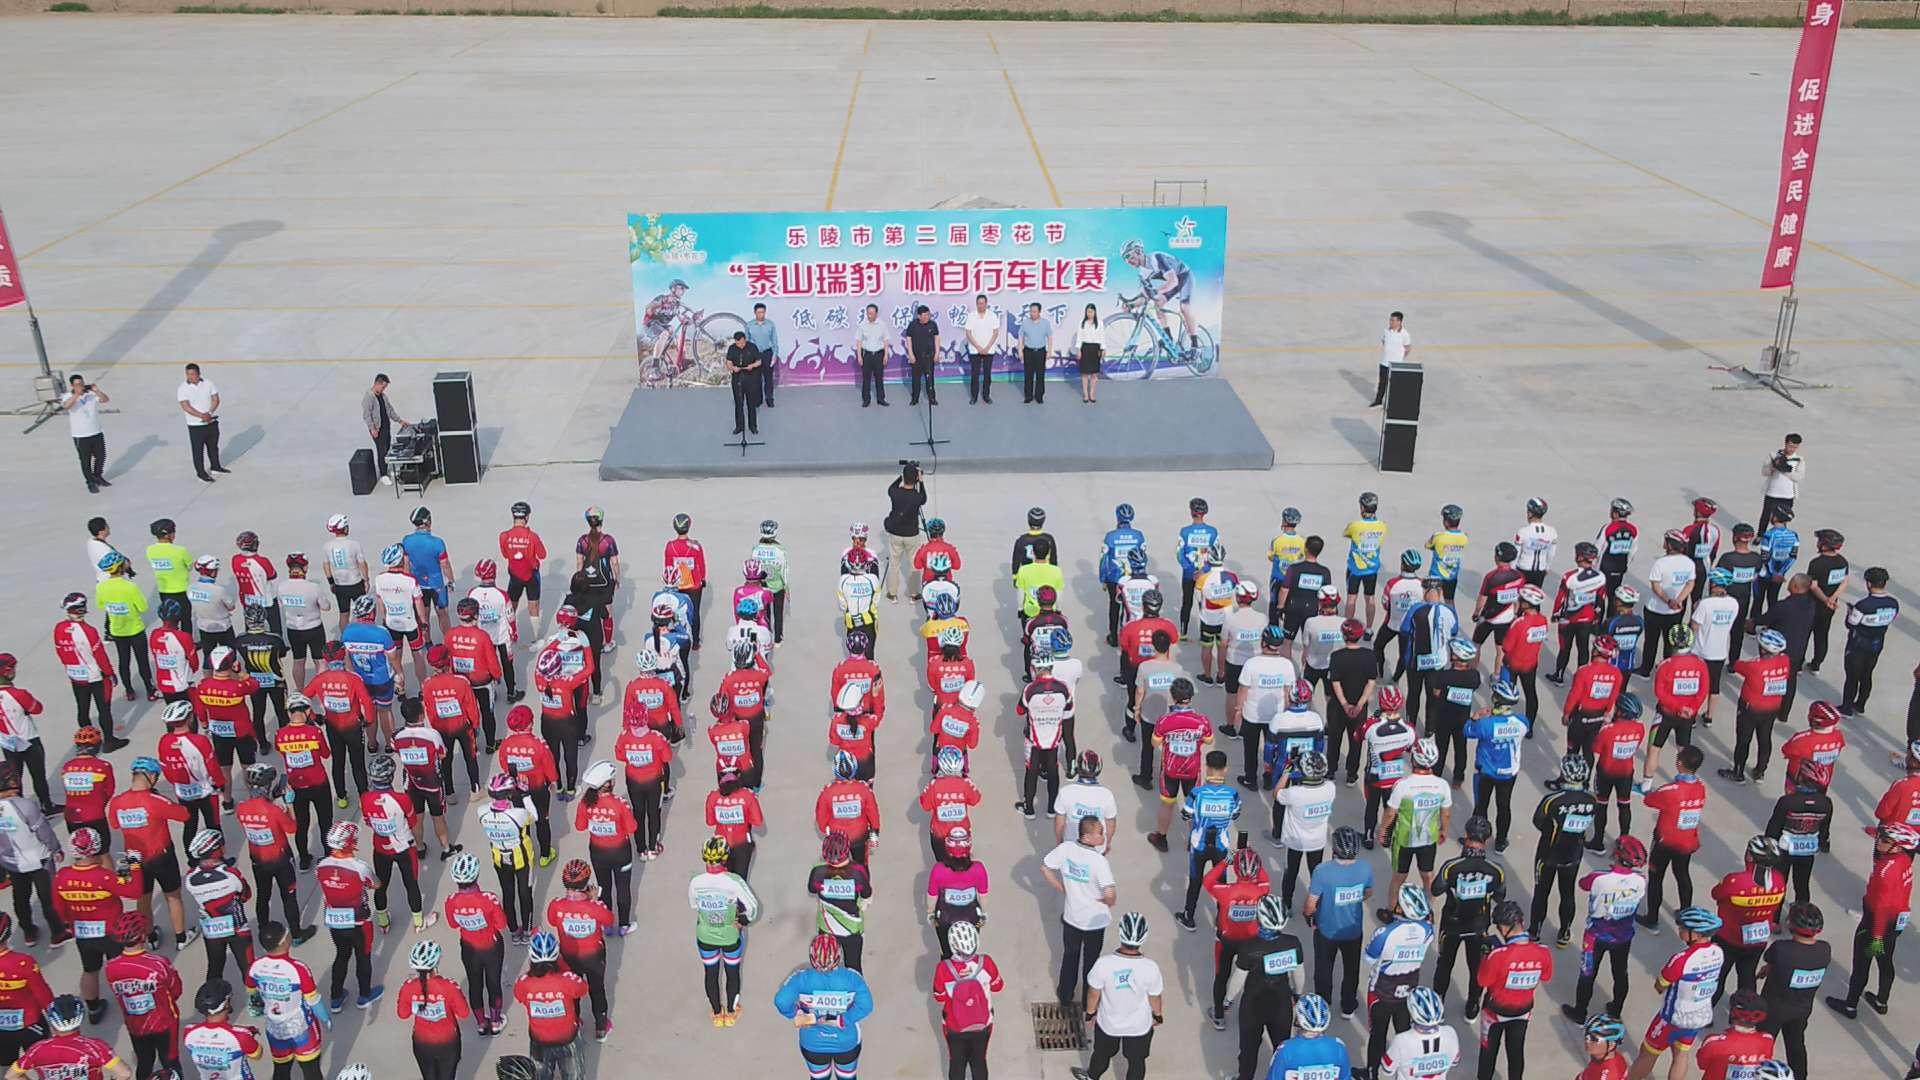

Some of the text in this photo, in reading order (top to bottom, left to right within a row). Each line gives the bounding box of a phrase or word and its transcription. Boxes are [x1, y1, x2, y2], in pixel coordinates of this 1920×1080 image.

[1810, 2, 1834, 26] 身
[1773, 78, 1821, 269] 促进全民健康
[787, 224, 1065, 246] 乐陵市第二届枣花节
[727, 257, 1107, 297] “泰山瑞豹”杯自行车比赛
[1204, 804, 1228, 812] B034
[719, 810, 740, 820] A041
[828, 886, 852, 894] A030
[948, 894, 971, 902] A053
[700, 900, 724, 909] A002
[328, 914, 350, 922] T035
[568, 924, 592, 932] A051
[1398, 950, 1420, 958] B011
[1512, 976, 1536, 984] B111
[816, 997, 843, 1006] A001
[1418, 1060, 1444, 1070] B009
[1303, 1072, 1332, 1080] B010
